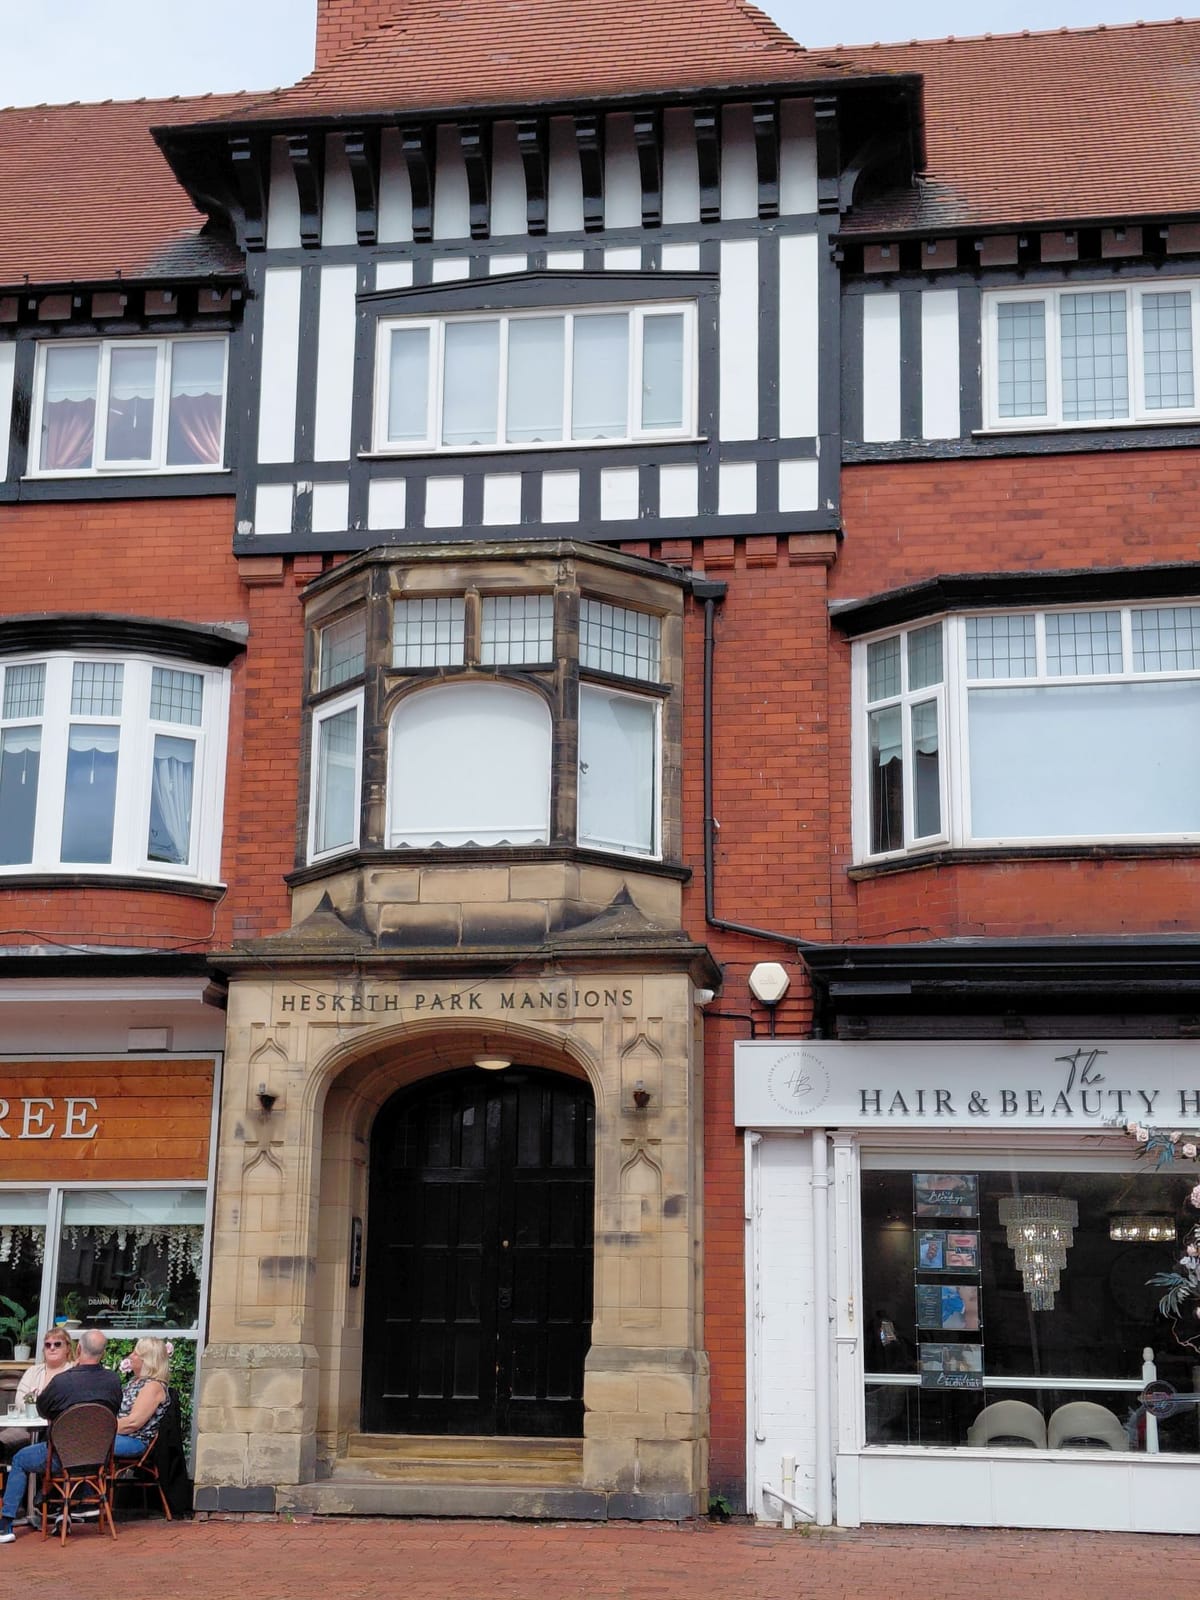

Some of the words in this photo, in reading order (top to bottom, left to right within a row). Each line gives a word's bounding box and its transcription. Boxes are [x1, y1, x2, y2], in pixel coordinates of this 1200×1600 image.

[281, 994, 399, 1012] HESKETH
[415, 992, 484, 1011] PARK
[500, 989, 633, 1009] MANSIONS
[1055, 1048, 1108, 1094] The
